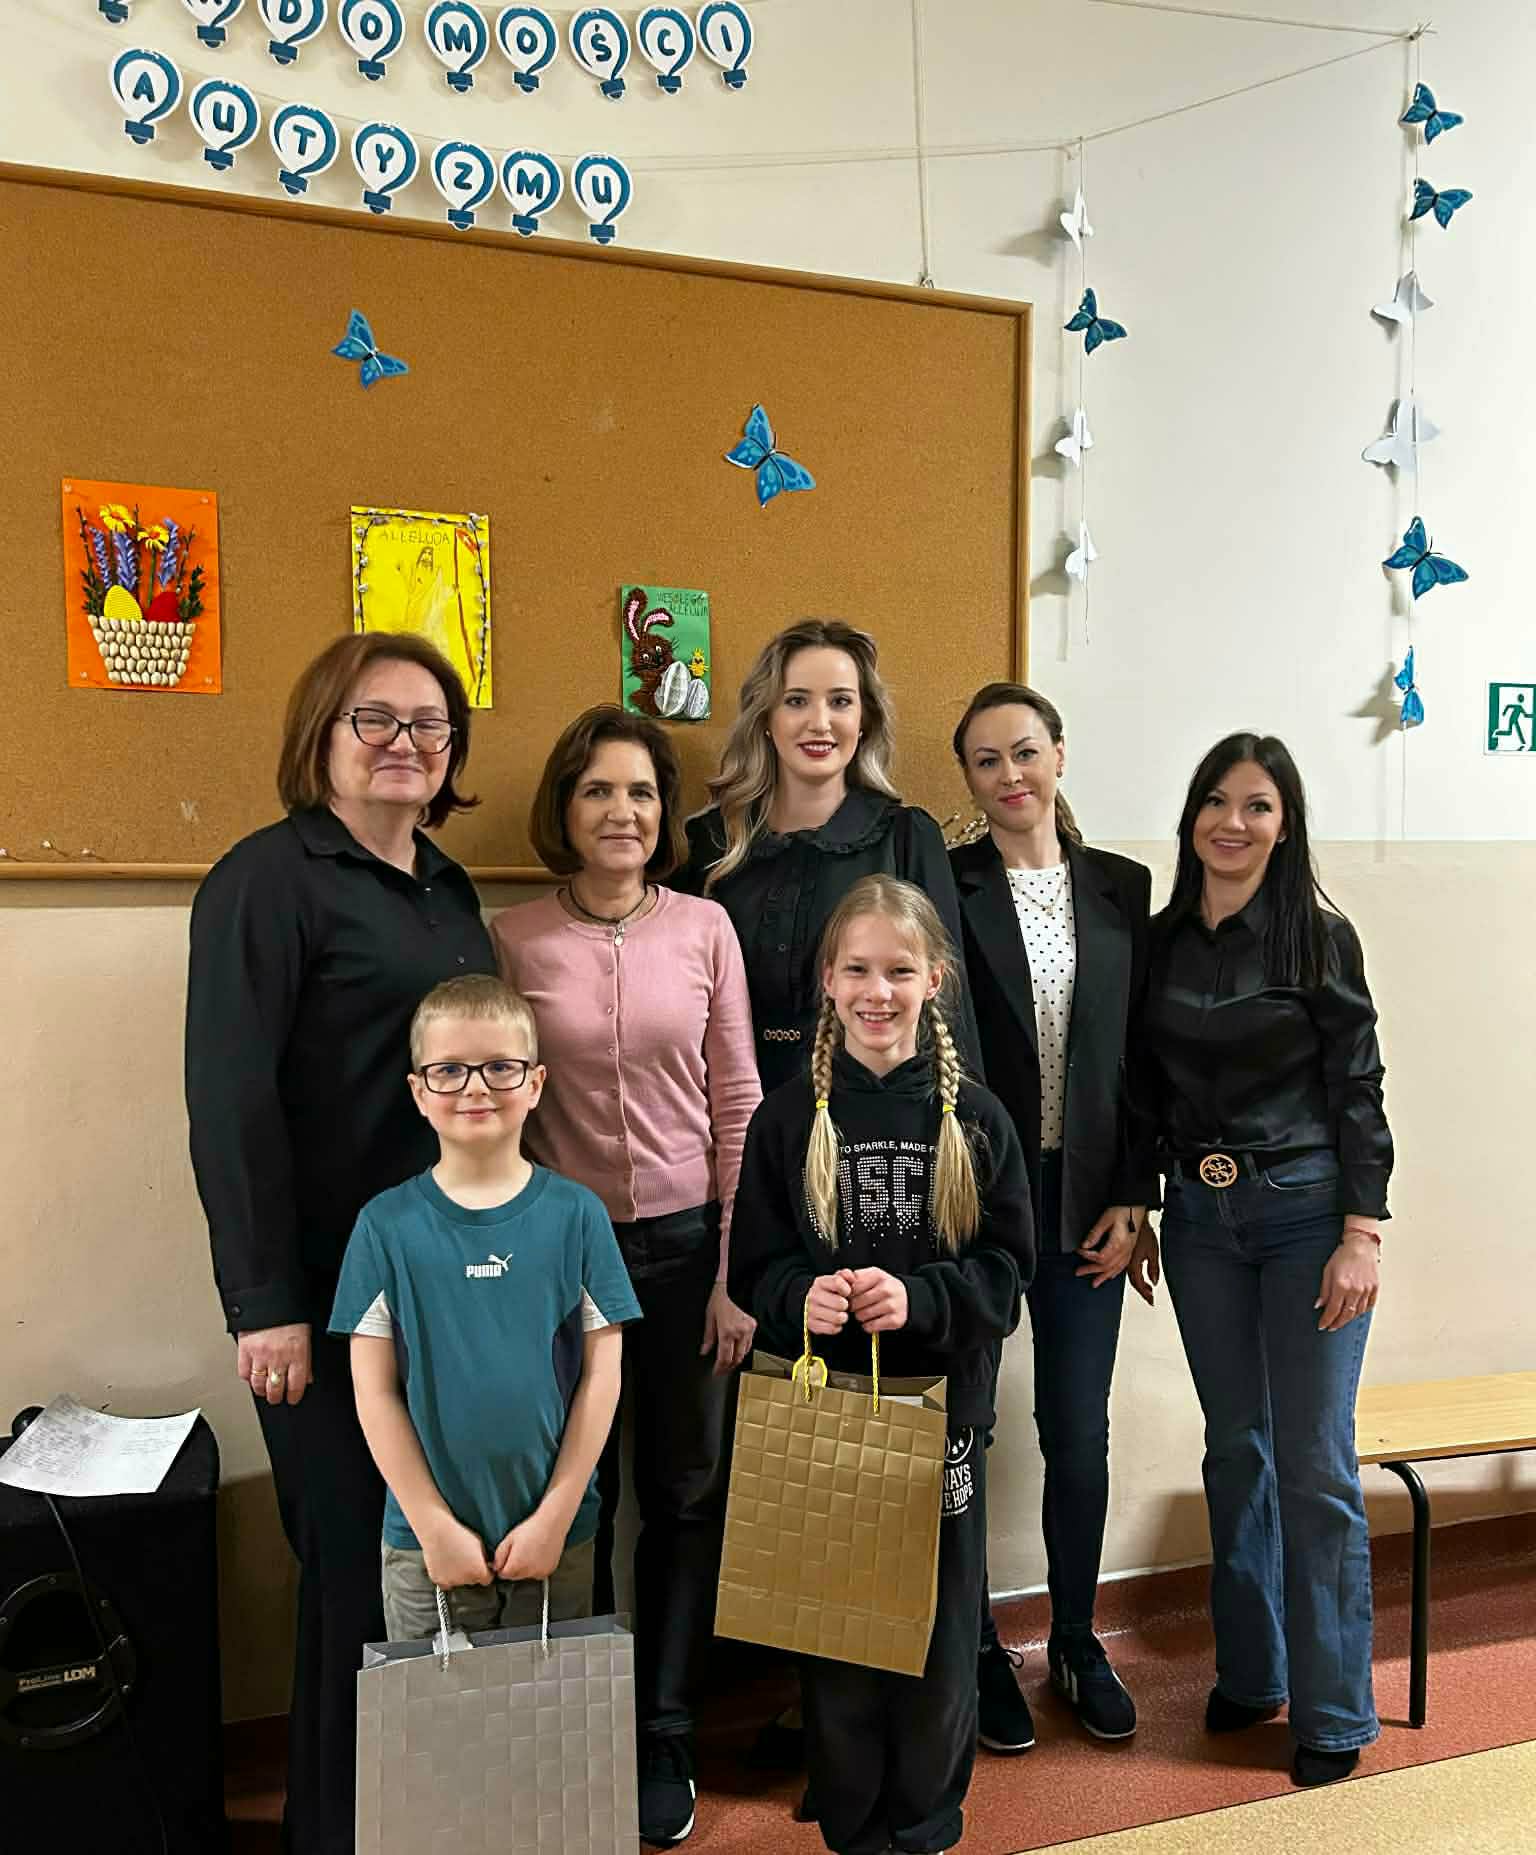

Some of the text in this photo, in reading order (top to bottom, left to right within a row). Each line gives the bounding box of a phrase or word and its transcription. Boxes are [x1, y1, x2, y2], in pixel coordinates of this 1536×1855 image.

[132, 71, 613, 204] AUTYZMU
[854, 1140, 898, 1152] SPARKLE,
[900, 1141, 927, 1152] MADE
[466, 1264, 502, 1278] PUMA
[953, 1481, 973, 1508] HOPE
